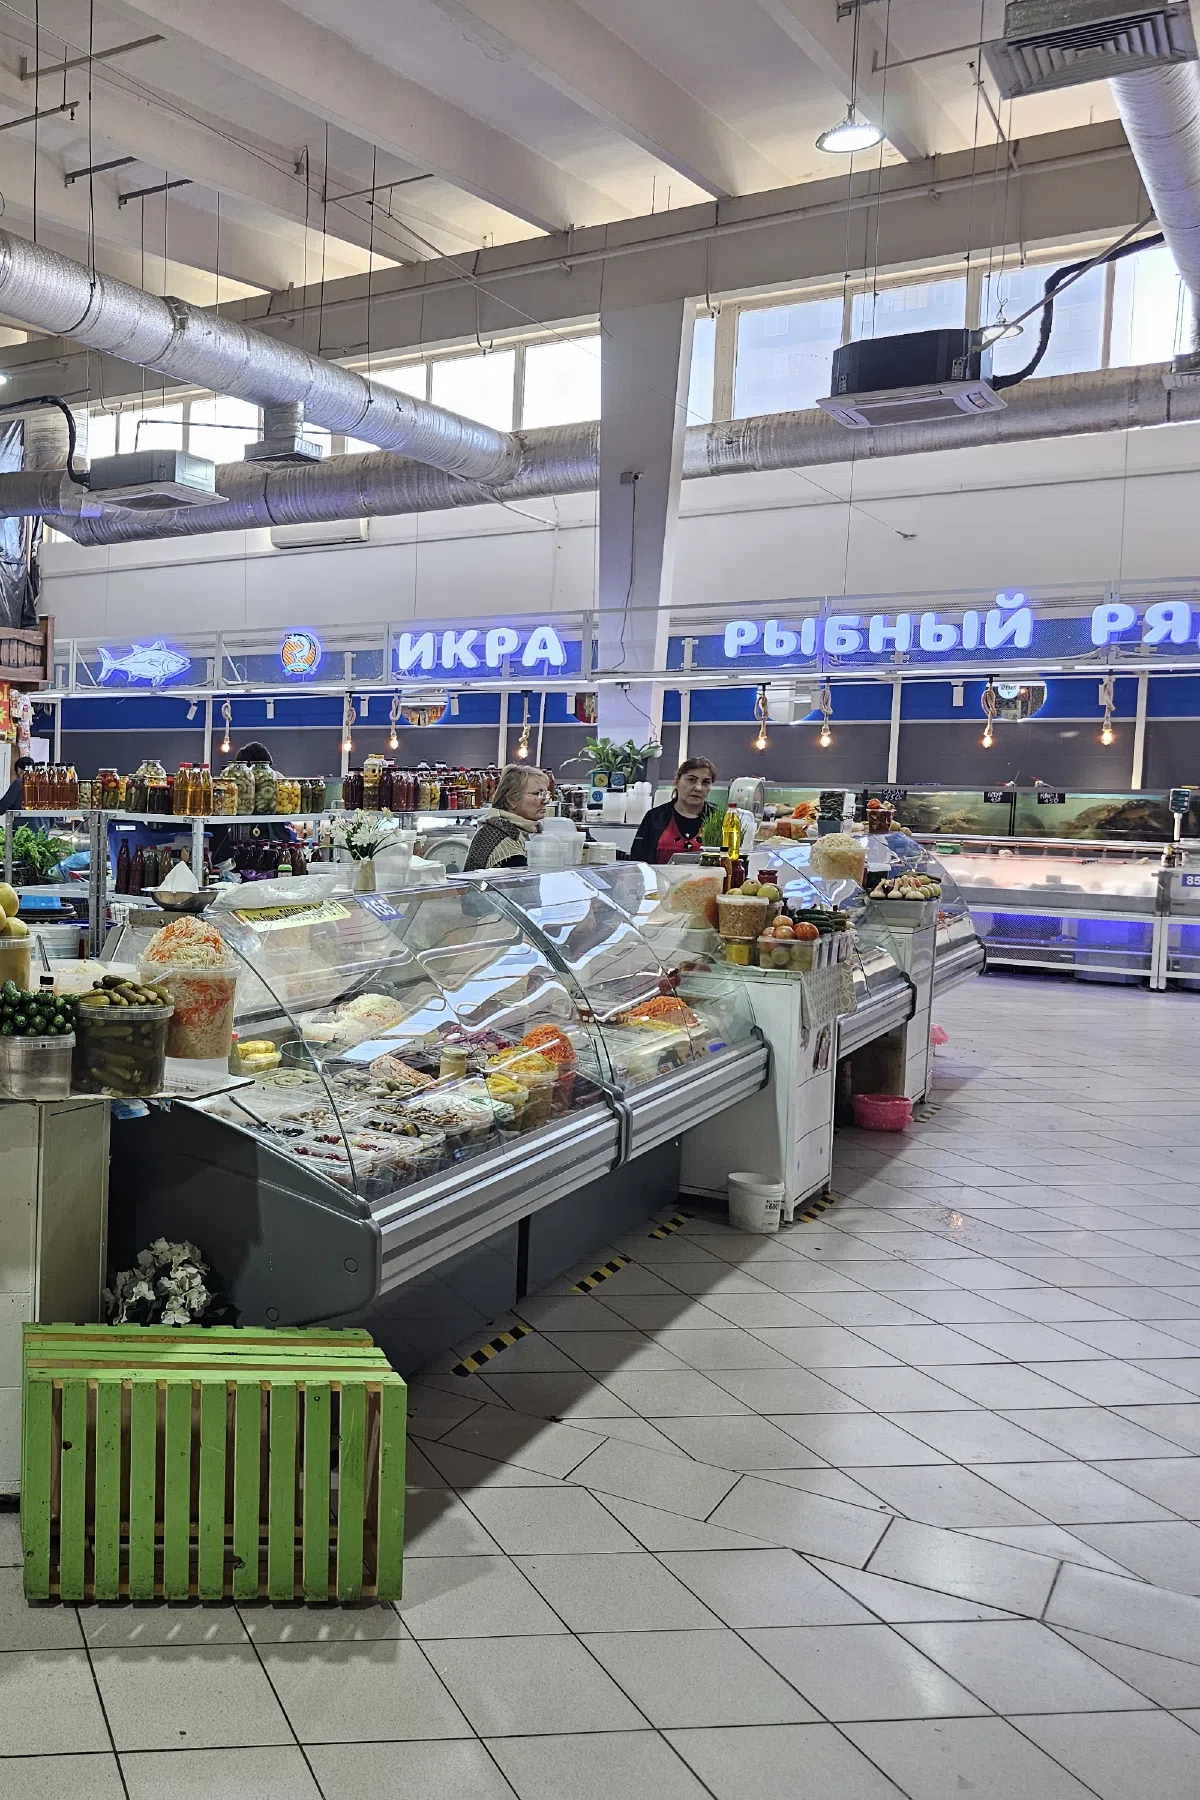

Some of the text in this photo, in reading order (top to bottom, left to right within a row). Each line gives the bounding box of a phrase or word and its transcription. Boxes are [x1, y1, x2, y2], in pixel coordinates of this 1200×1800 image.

[723, 592, 1200, 658] РЫБНЫЙ РЯ
[399, 627, 567, 670] ИКРА
[363, 898, 397, 917] 165
